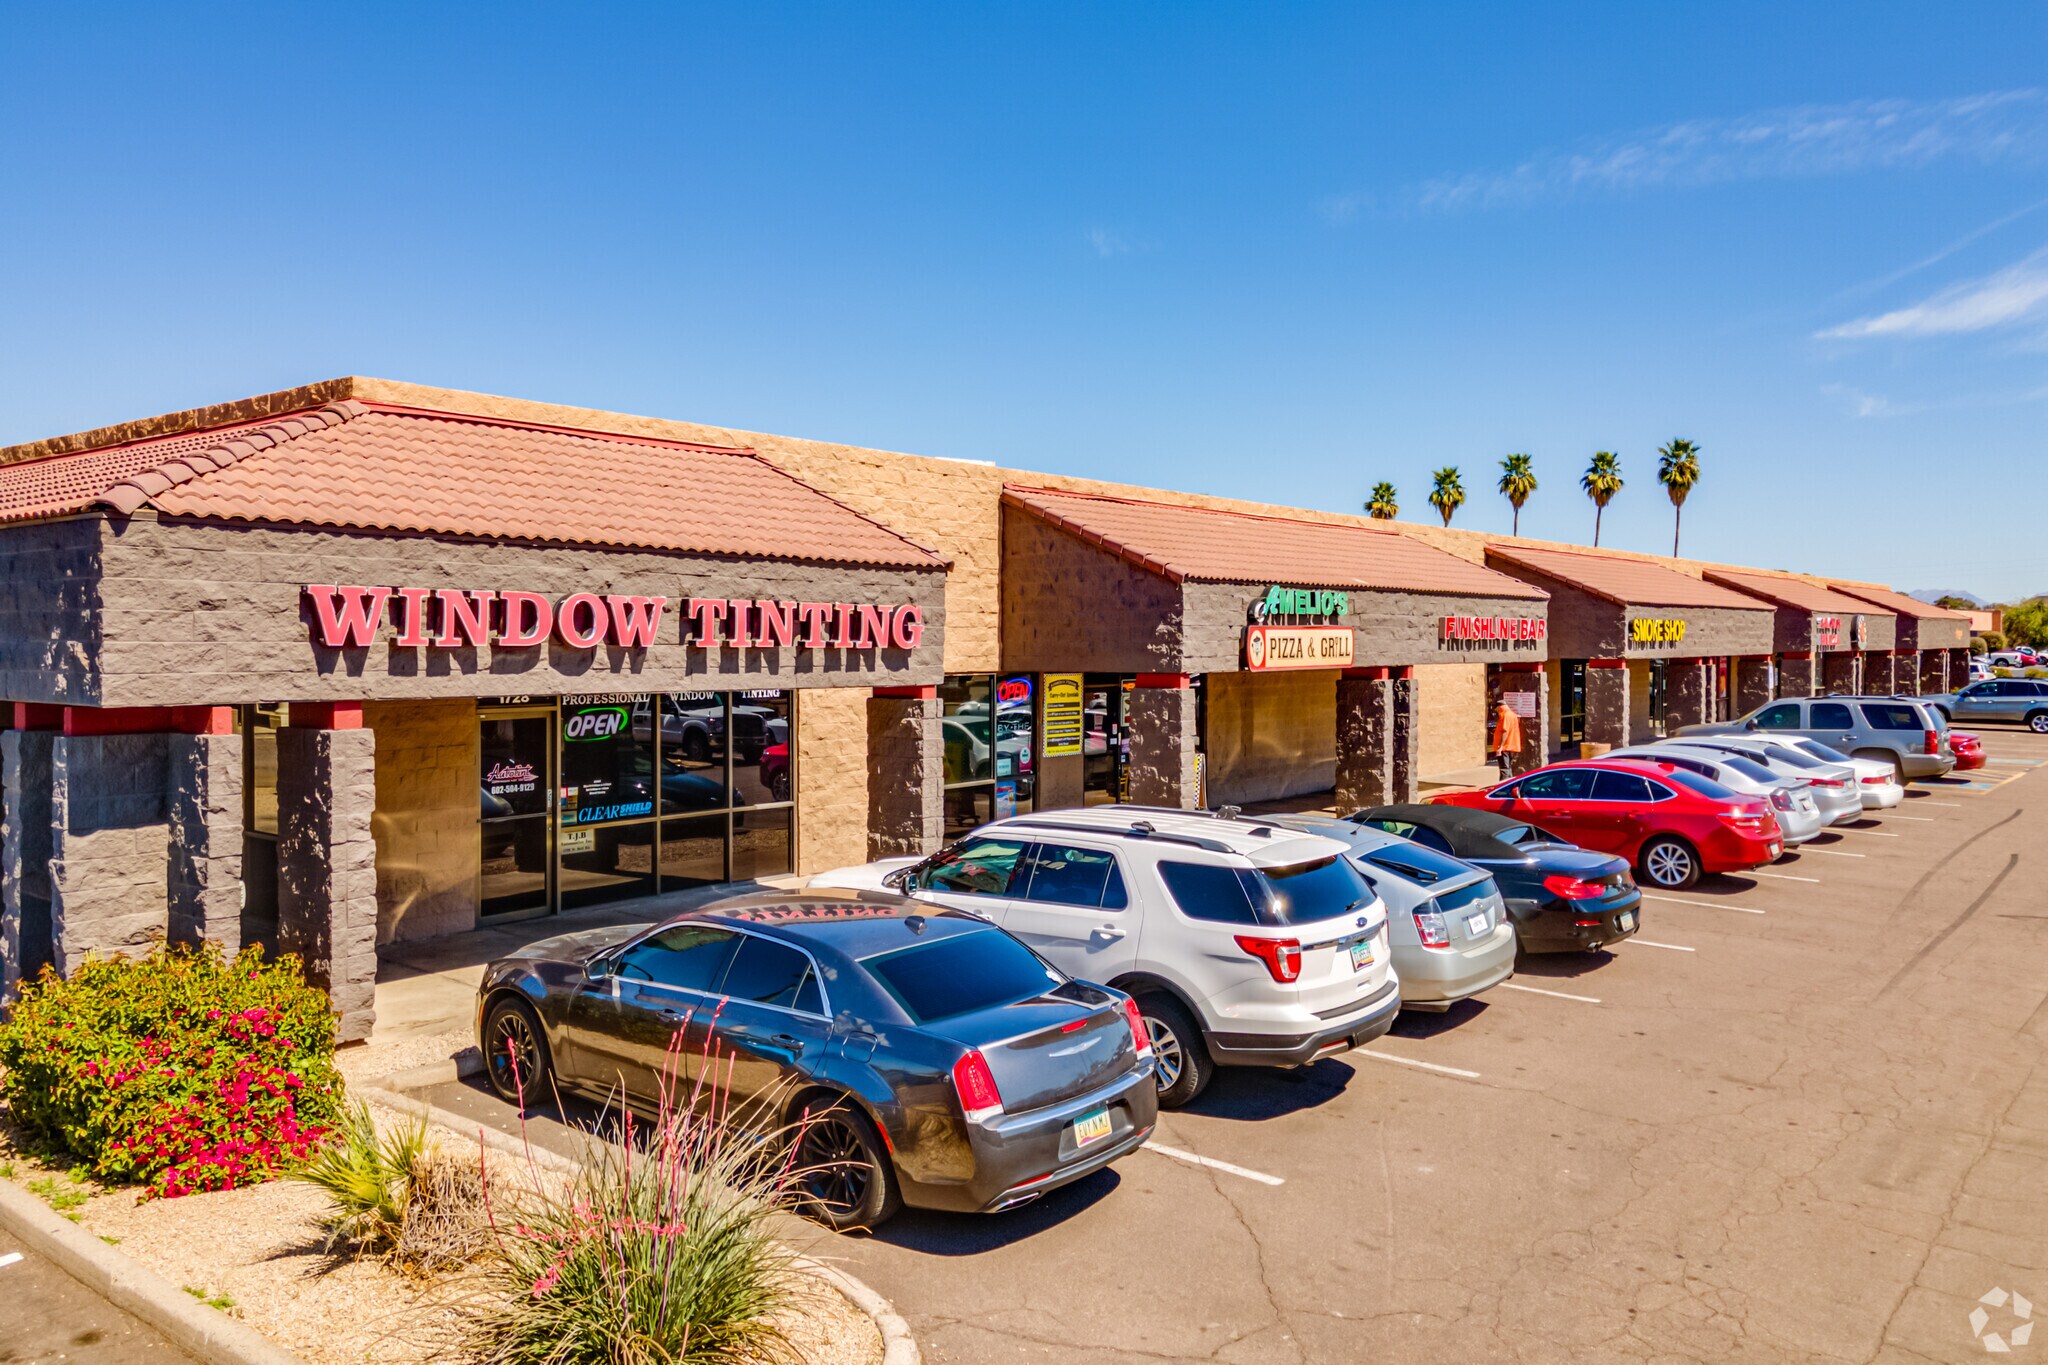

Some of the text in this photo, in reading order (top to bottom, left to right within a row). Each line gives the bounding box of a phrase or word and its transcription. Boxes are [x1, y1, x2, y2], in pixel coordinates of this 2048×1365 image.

[1264, 584, 1349, 616] AMELIO'S
[305, 584, 924, 650] WINDOW TINTING
[1520, 618, 1546, 641] BAR
[1633, 618, 1686, 642] SMOKE SHOP
[1270, 636, 1351, 659] PIZZA & GRILL
[562, 688, 780, 706] PROFESSIONAL WINDOW TINTING
[1000, 680, 1029, 701] OPEN
[566, 713, 622, 738] OPEN
